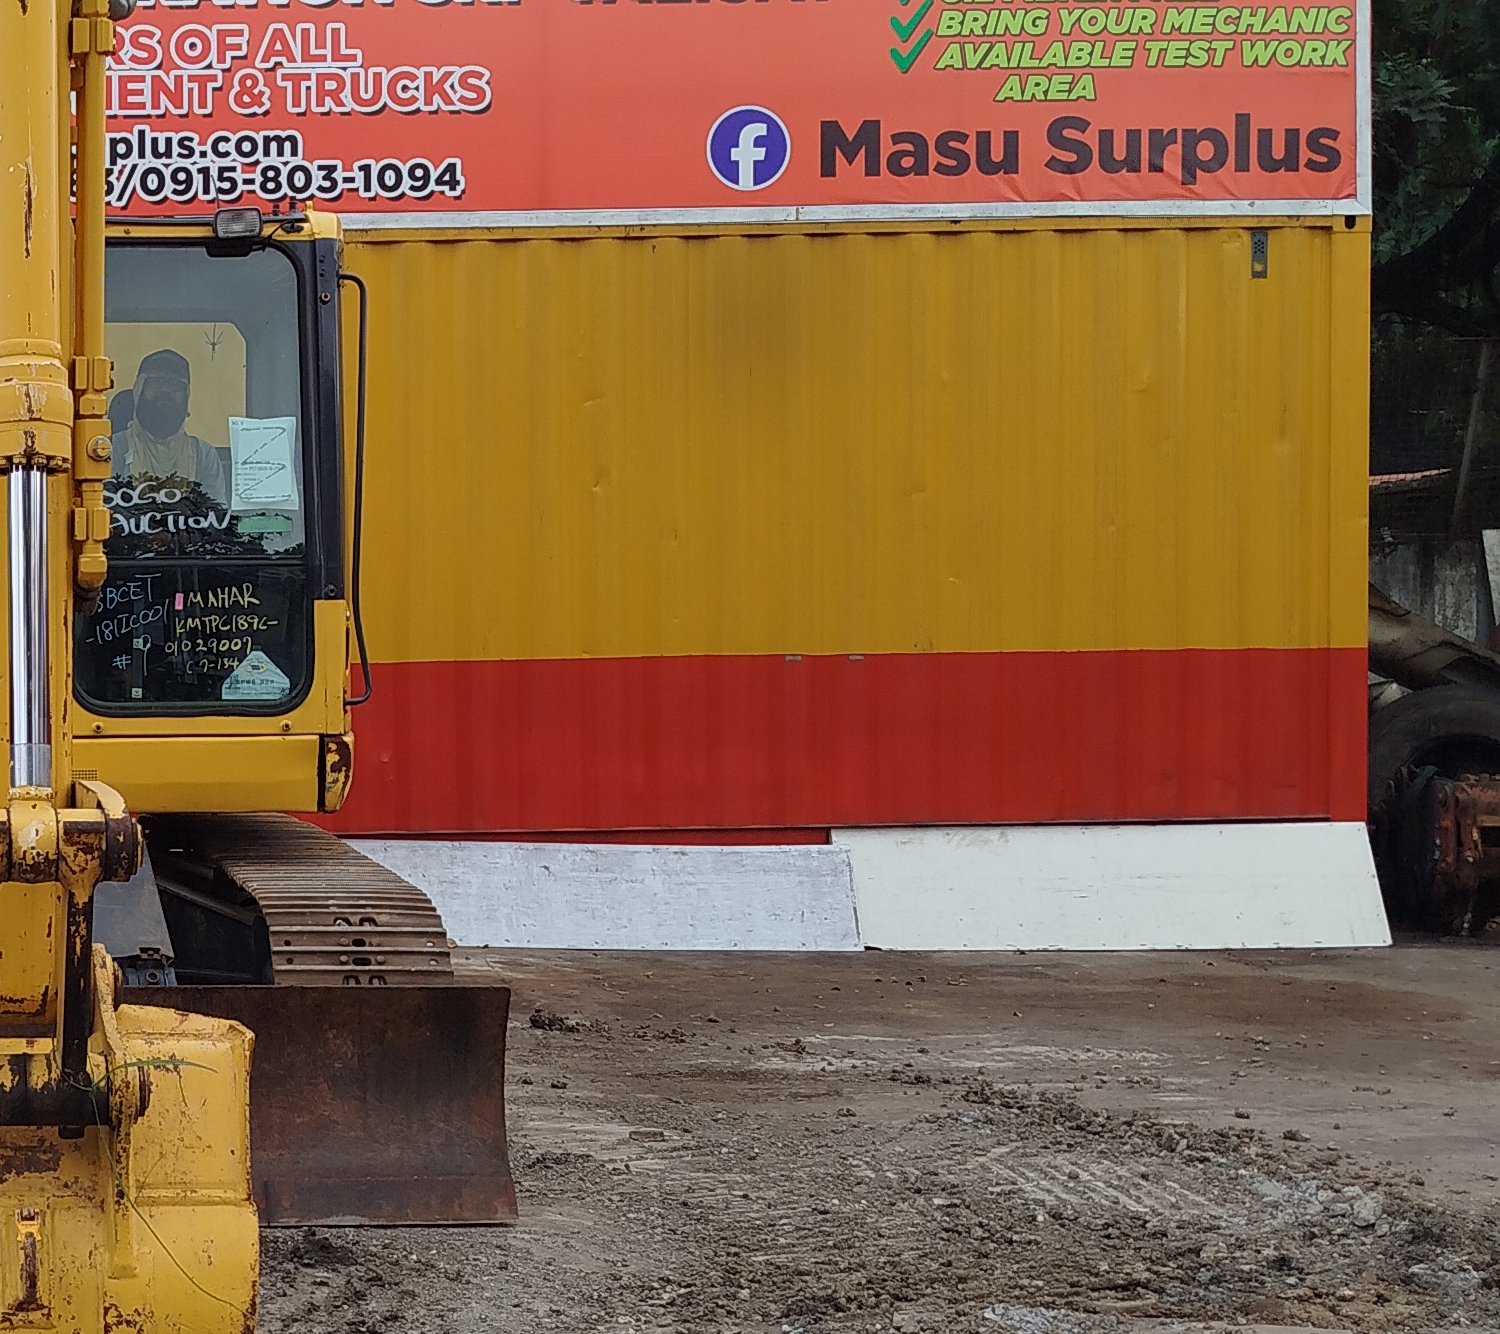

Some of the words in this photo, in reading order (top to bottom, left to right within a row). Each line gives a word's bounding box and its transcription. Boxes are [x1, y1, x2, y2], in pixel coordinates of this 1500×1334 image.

[935, 9, 1049, 37] BRING
[1059, 8, 1157, 36] YOUR
[1162, 7, 1353, 35] MECHANIC
[169, 23, 248, 69] OF
[256, 22, 362, 67] ALL
[934, 41, 1139, 69] AVAILABLE
[1145, 40, 1234, 68] TEST
[1241, 39, 1353, 67] WORK
[230, 67, 271, 115] &
[276, 65, 493, 113] TRUCKS
[993, 74, 1097, 102] AREA
[819, 118, 1020, 178] Masu
[1043, 112, 1342, 186] Surplus
[110, 509, 232, 537] AUCTION
[186, 582, 261, 609] MAHAR
